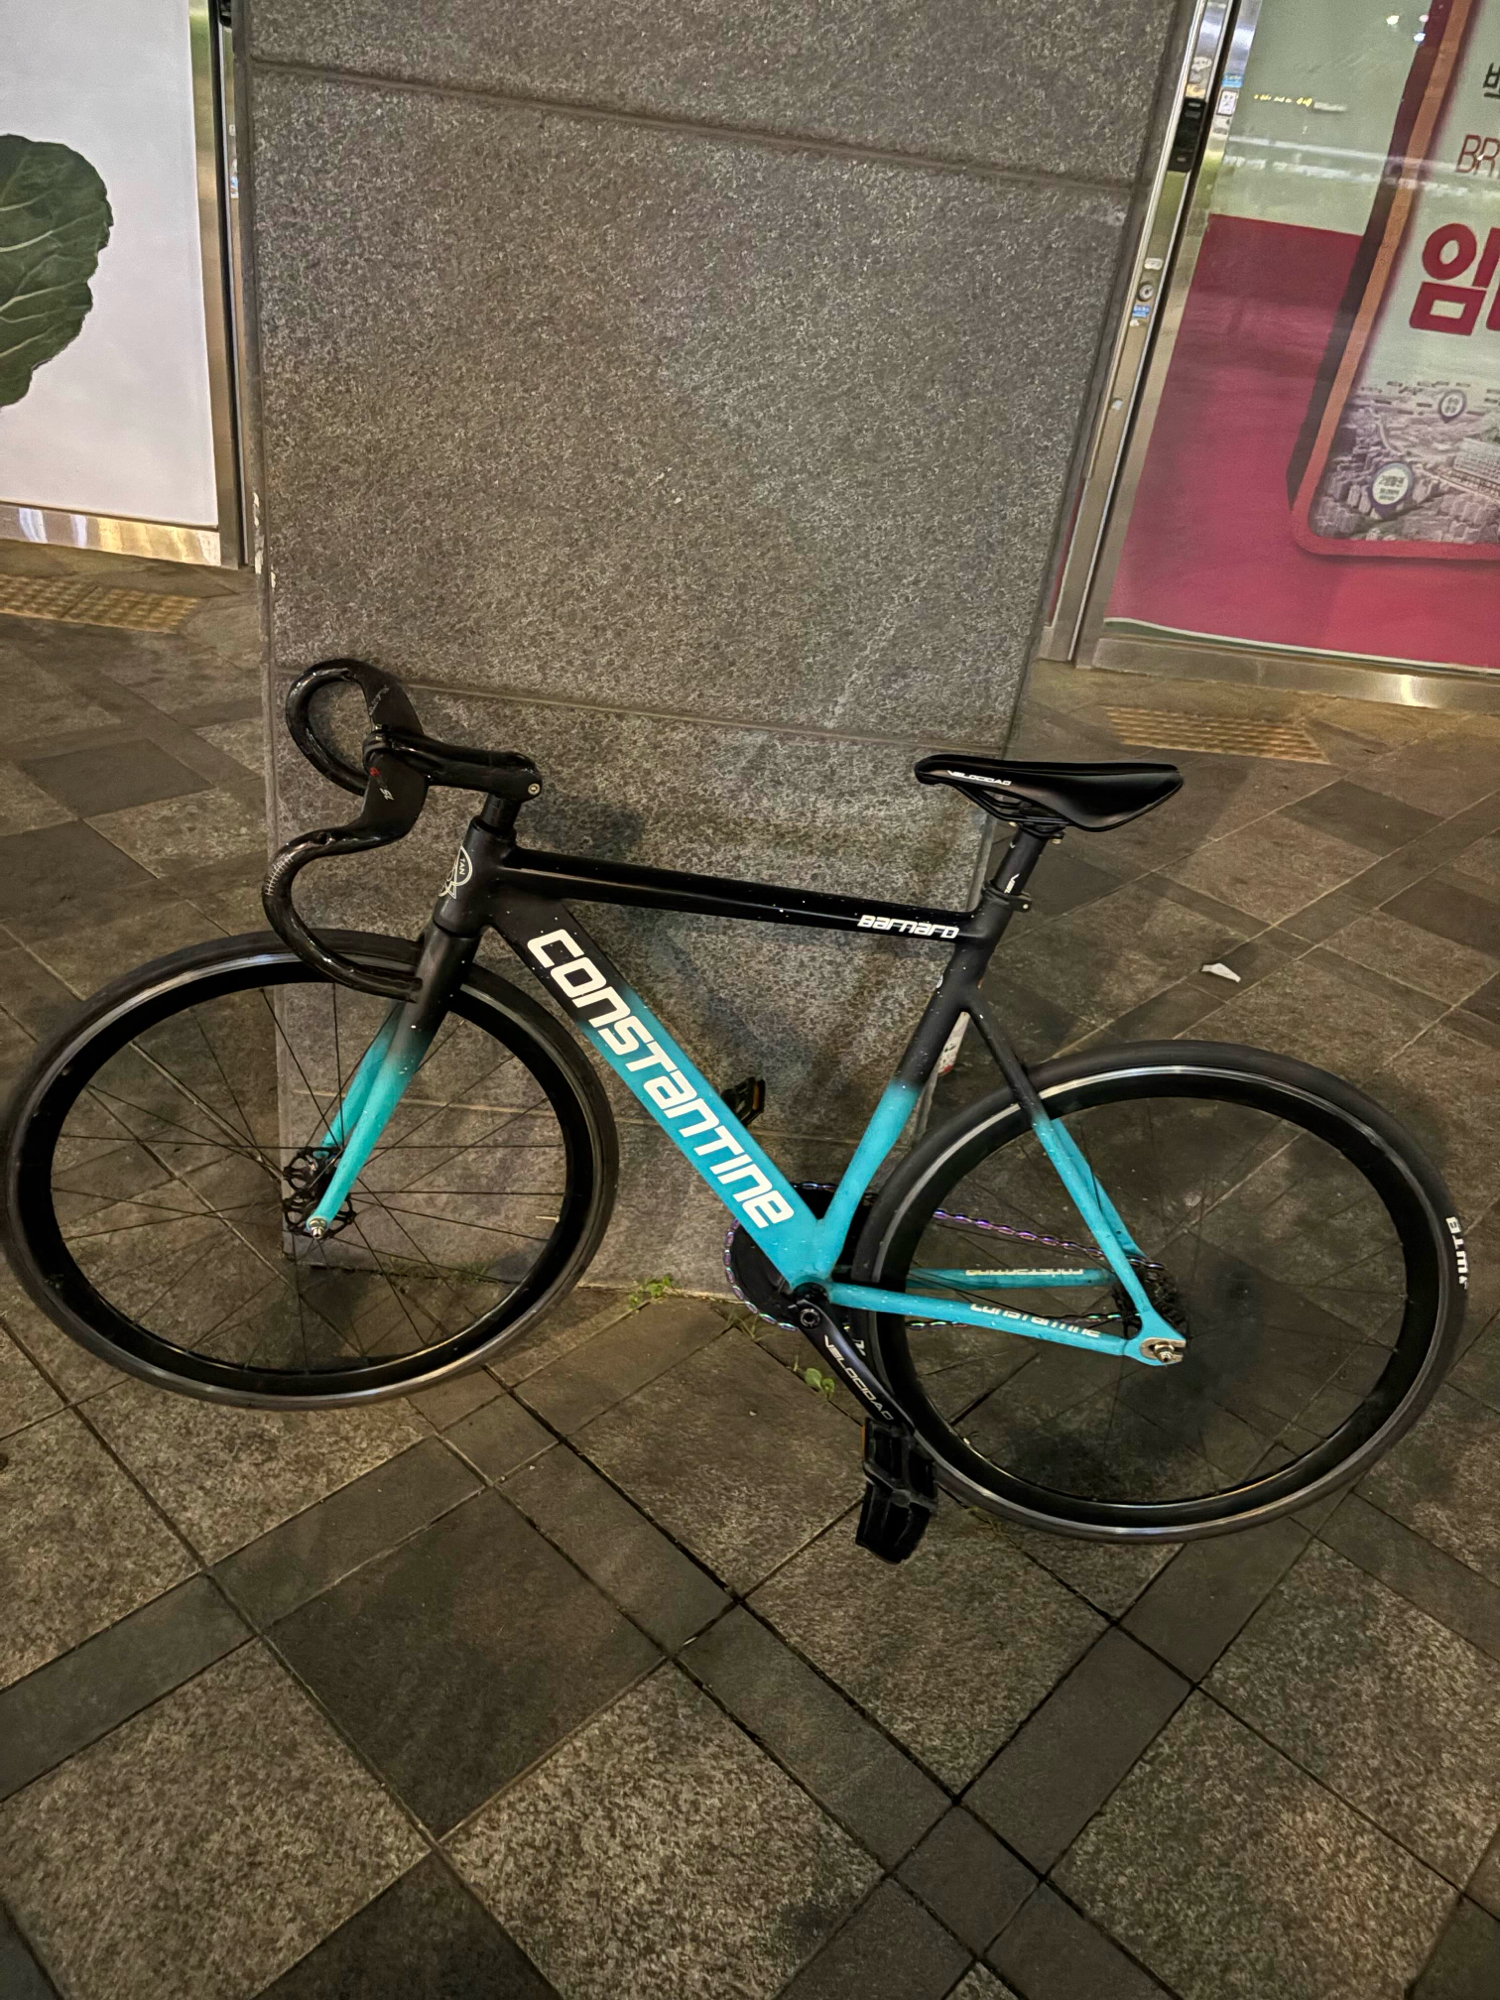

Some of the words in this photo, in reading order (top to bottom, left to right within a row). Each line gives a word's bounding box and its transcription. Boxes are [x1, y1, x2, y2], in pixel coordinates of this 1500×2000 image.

[1456, 134, 1500, 177] BR
[1409, 222, 1500, 336] 임
[823, 1334, 895, 1421] VELOCIDAD
